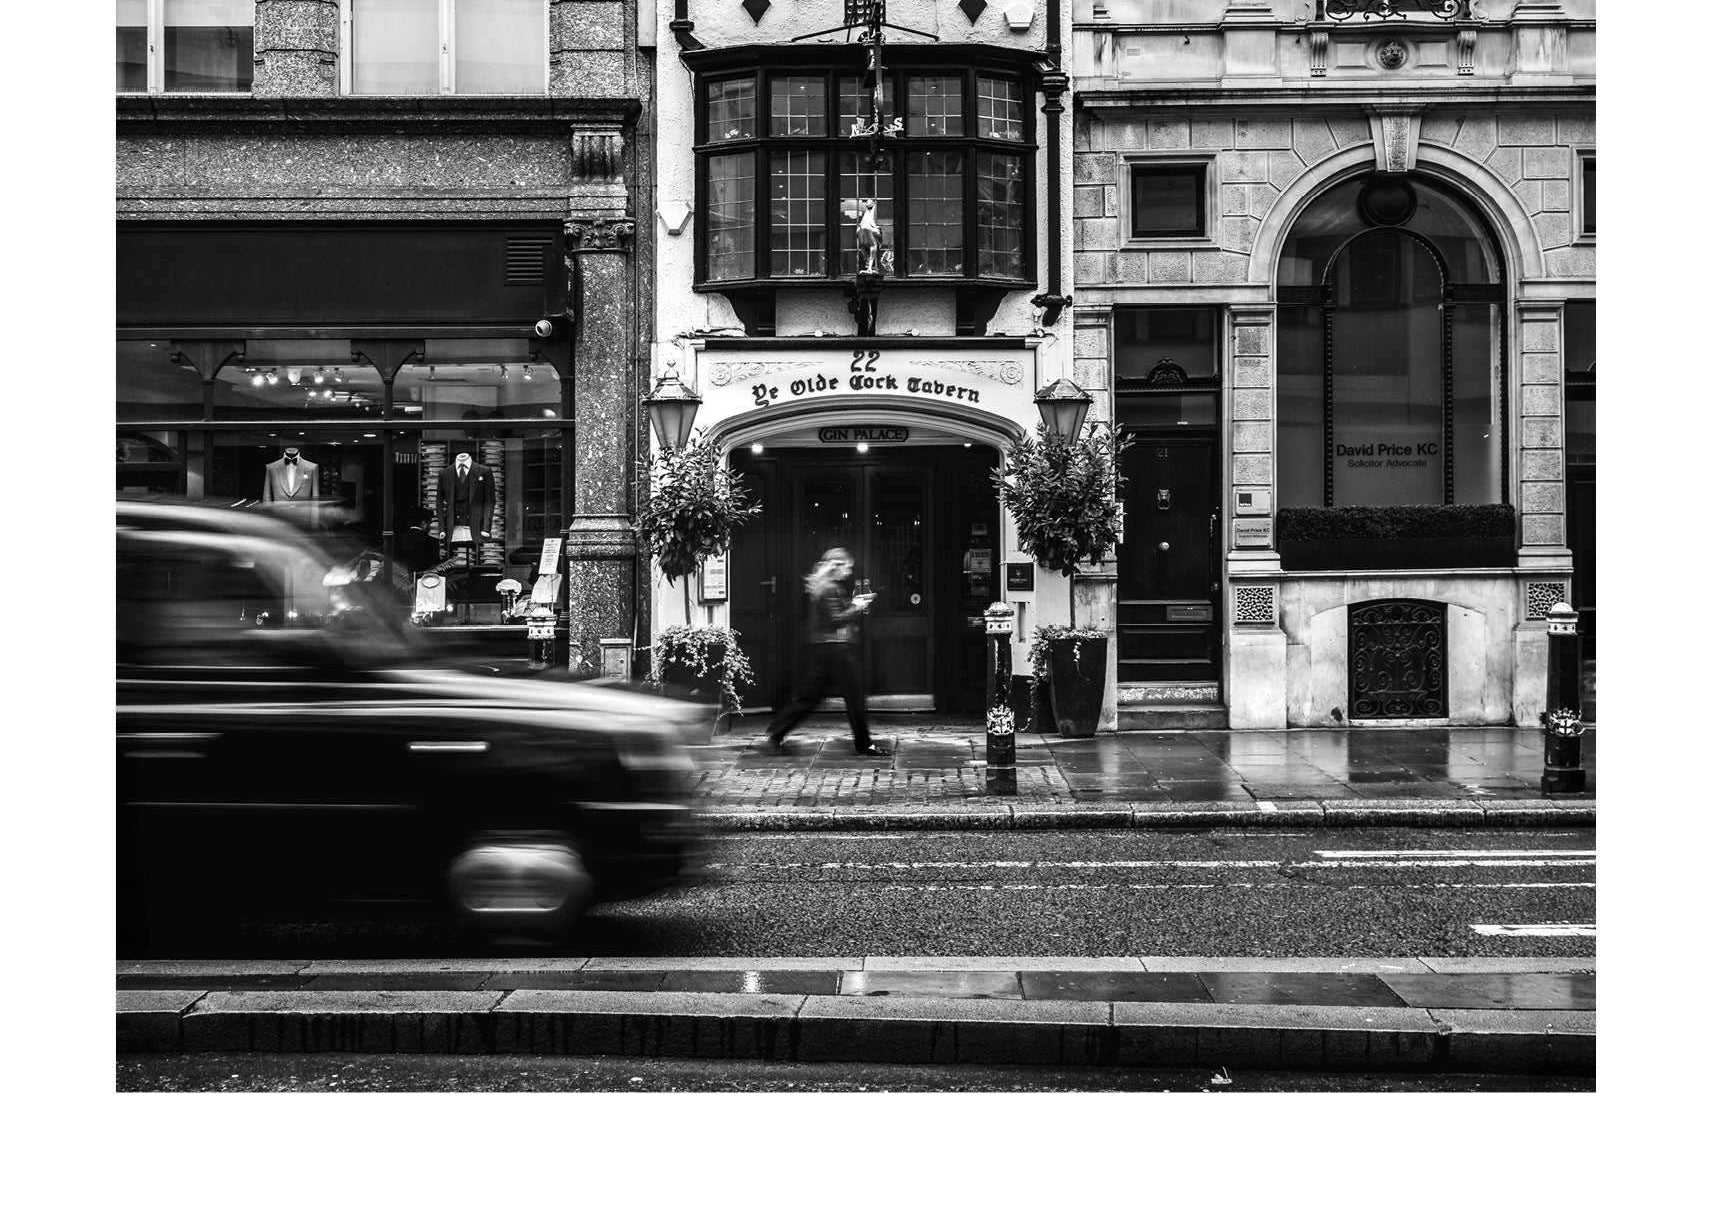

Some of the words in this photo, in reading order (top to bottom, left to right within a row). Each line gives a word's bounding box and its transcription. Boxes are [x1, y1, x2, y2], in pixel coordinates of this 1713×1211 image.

[850, 350, 880, 372] 22
[752, 383, 779, 407] Ye
[790, 373, 839, 396] Olde
[849, 374, 899, 391] Cock
[907, 377, 980, 403] Tavern
[822, 428, 849, 441] GIN
[853, 428, 904, 440] PALACE
[1157, 447, 1168, 457] 21
[1336, 443, 1375, 456] David
[1378, 443, 1413, 456] Price
[1417, 443, 1438, 456] KC
[1347, 459, 1383, 468] Solicitor
[1386, 459, 1428, 467] Advocate
